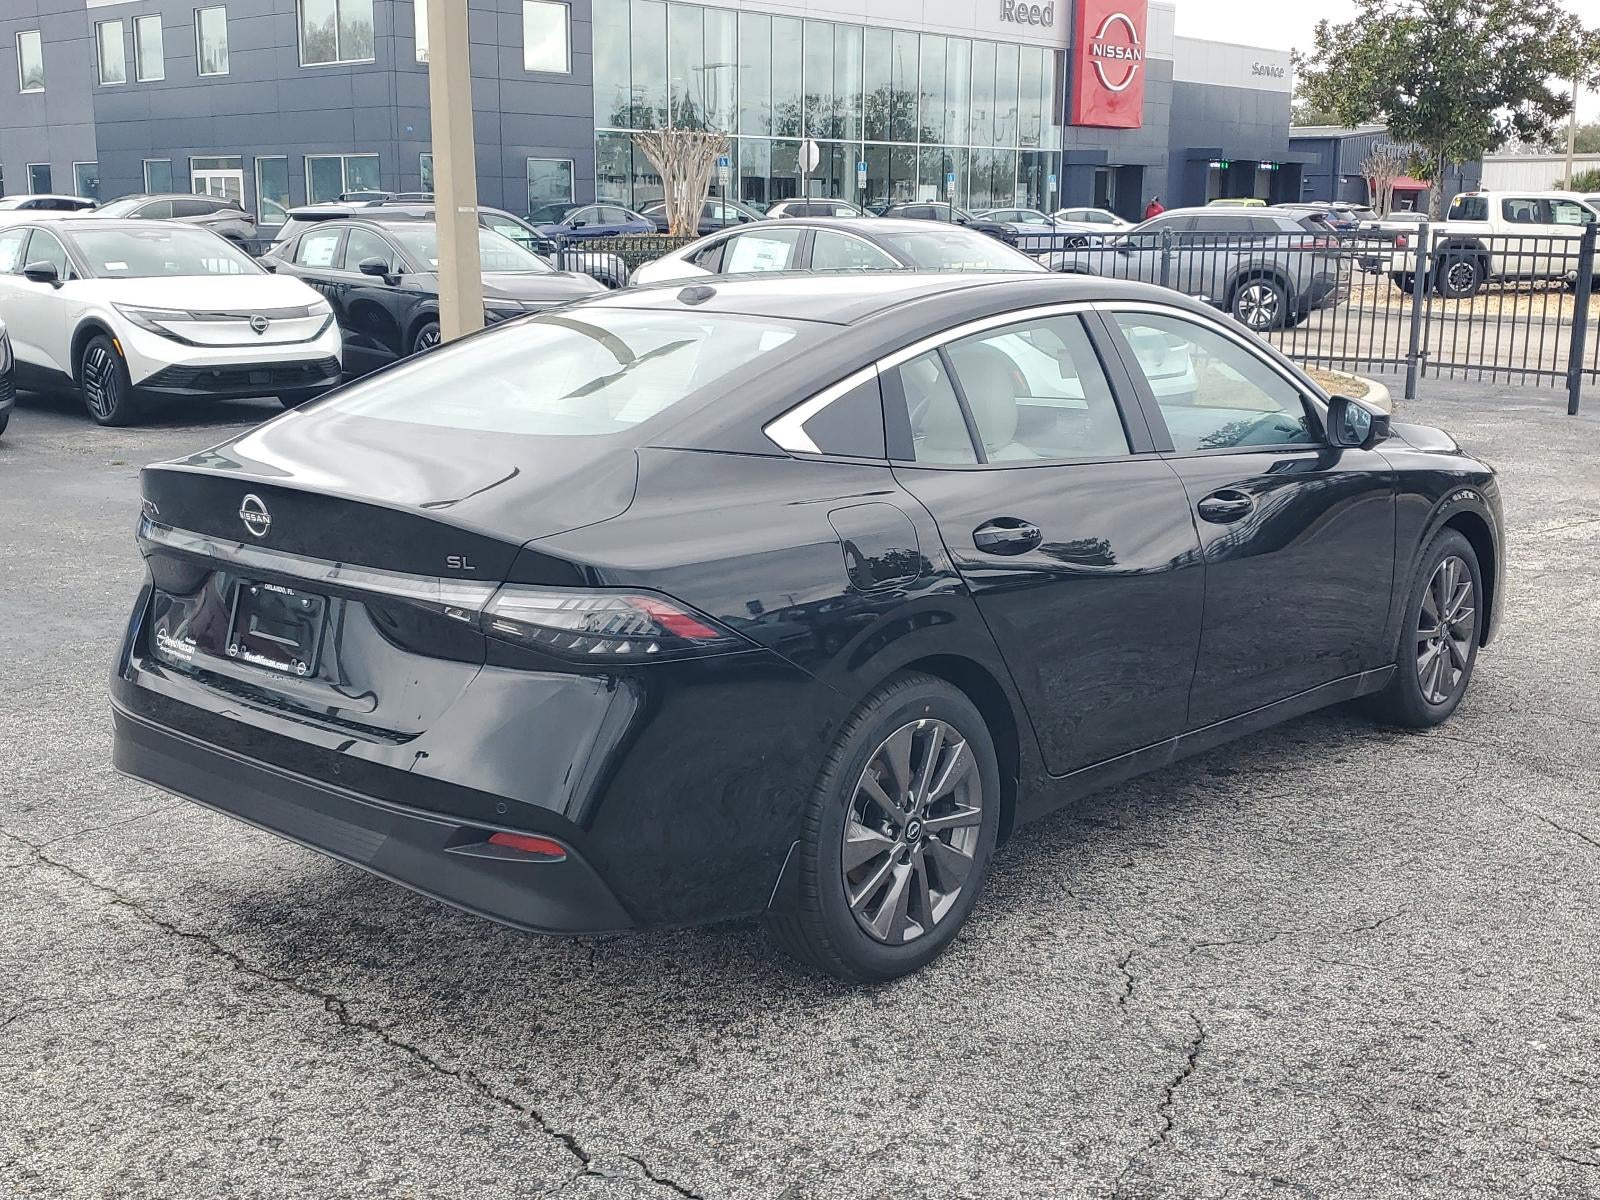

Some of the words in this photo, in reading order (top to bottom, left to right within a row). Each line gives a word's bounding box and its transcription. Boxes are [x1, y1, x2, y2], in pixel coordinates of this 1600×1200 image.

[1000, 0, 1054, 27] Reed
[1091, 43, 1142, 61] NISSAN
[1251, 62, 1285, 77] Service
[240, 510, 271, 525] NISSAN
[447, 555, 476, 570] SL
[244, 651, 289, 671] ReedNissan.com
